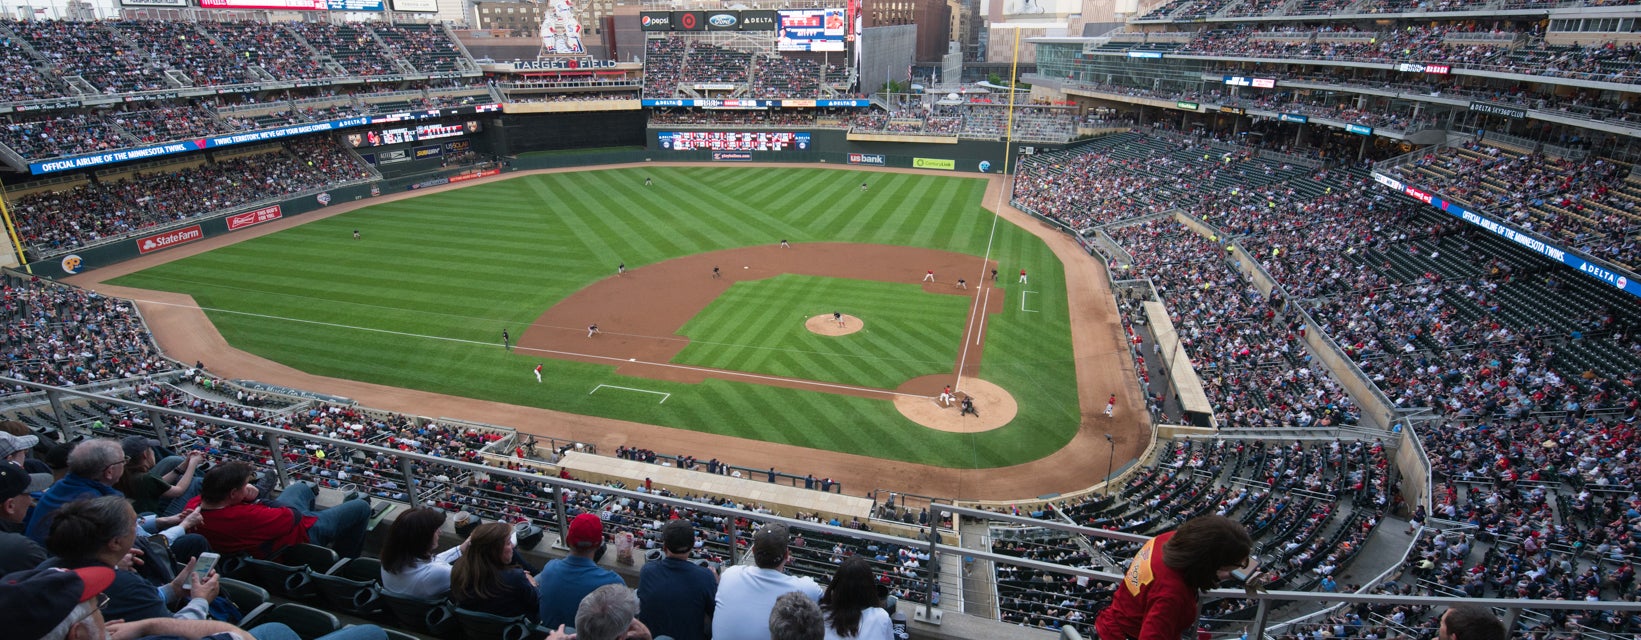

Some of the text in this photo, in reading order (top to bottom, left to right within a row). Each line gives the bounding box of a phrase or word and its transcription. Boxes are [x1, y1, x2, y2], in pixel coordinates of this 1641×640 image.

[652, 17, 669, 25] pepsi
[714, 15, 732, 26] Ford
[513, 60, 617, 69] TARGET FIELD
[1475, 104, 1491, 112] DELTA
[214, 136, 232, 146] TWINS
[276, 129, 286, 137] GOT
[286, 127, 299, 136] YOUR
[299, 126, 311, 134] BASES
[416, 147, 440, 157] SUBWAY
[42, 160, 76, 172] OFFICIAL
[76, 156, 103, 167] AIRLINE
[104, 154, 114, 163] OF
[114, 152, 128, 161] THE
[128, 147, 165, 159] MINNESOTA
[1462, 210, 1481, 225] OFFICIAL
[1480, 217, 1498, 233] AIRLINE
[1497, 225, 1505, 235] OF
[1504, 227, 1516, 240] THE
[1514, 232, 1546, 254] MINNESOTA
[1587, 264, 1614, 283] DELTA
